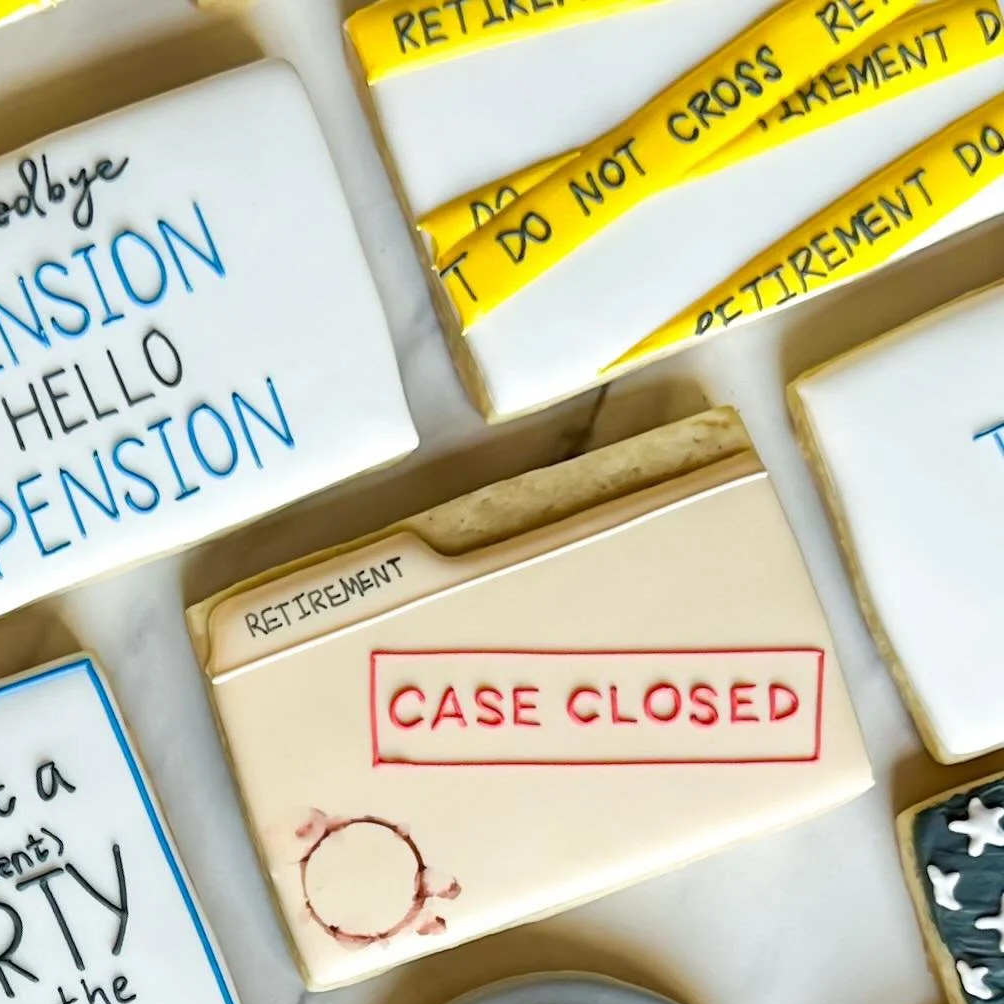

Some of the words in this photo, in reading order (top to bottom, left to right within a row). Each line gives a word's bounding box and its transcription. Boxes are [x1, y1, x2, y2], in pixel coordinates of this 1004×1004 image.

[757, 25, 948, 132] IREMENT
[496, 211, 552, 264] DO
[567, 137, 646, 216] NOT
[667, 44, 784, 145] CROSS
[814, 0, 890, 45] RE
[953, 124, 1004, 177] DO
[1, 328, 183, 451] HELLO
[245, 557, 407, 637] RETIREMENT
[388, 685, 541, 731] CASE
[566, 682, 800, 727] CLOSED
[36, 761, 75, 801] a
